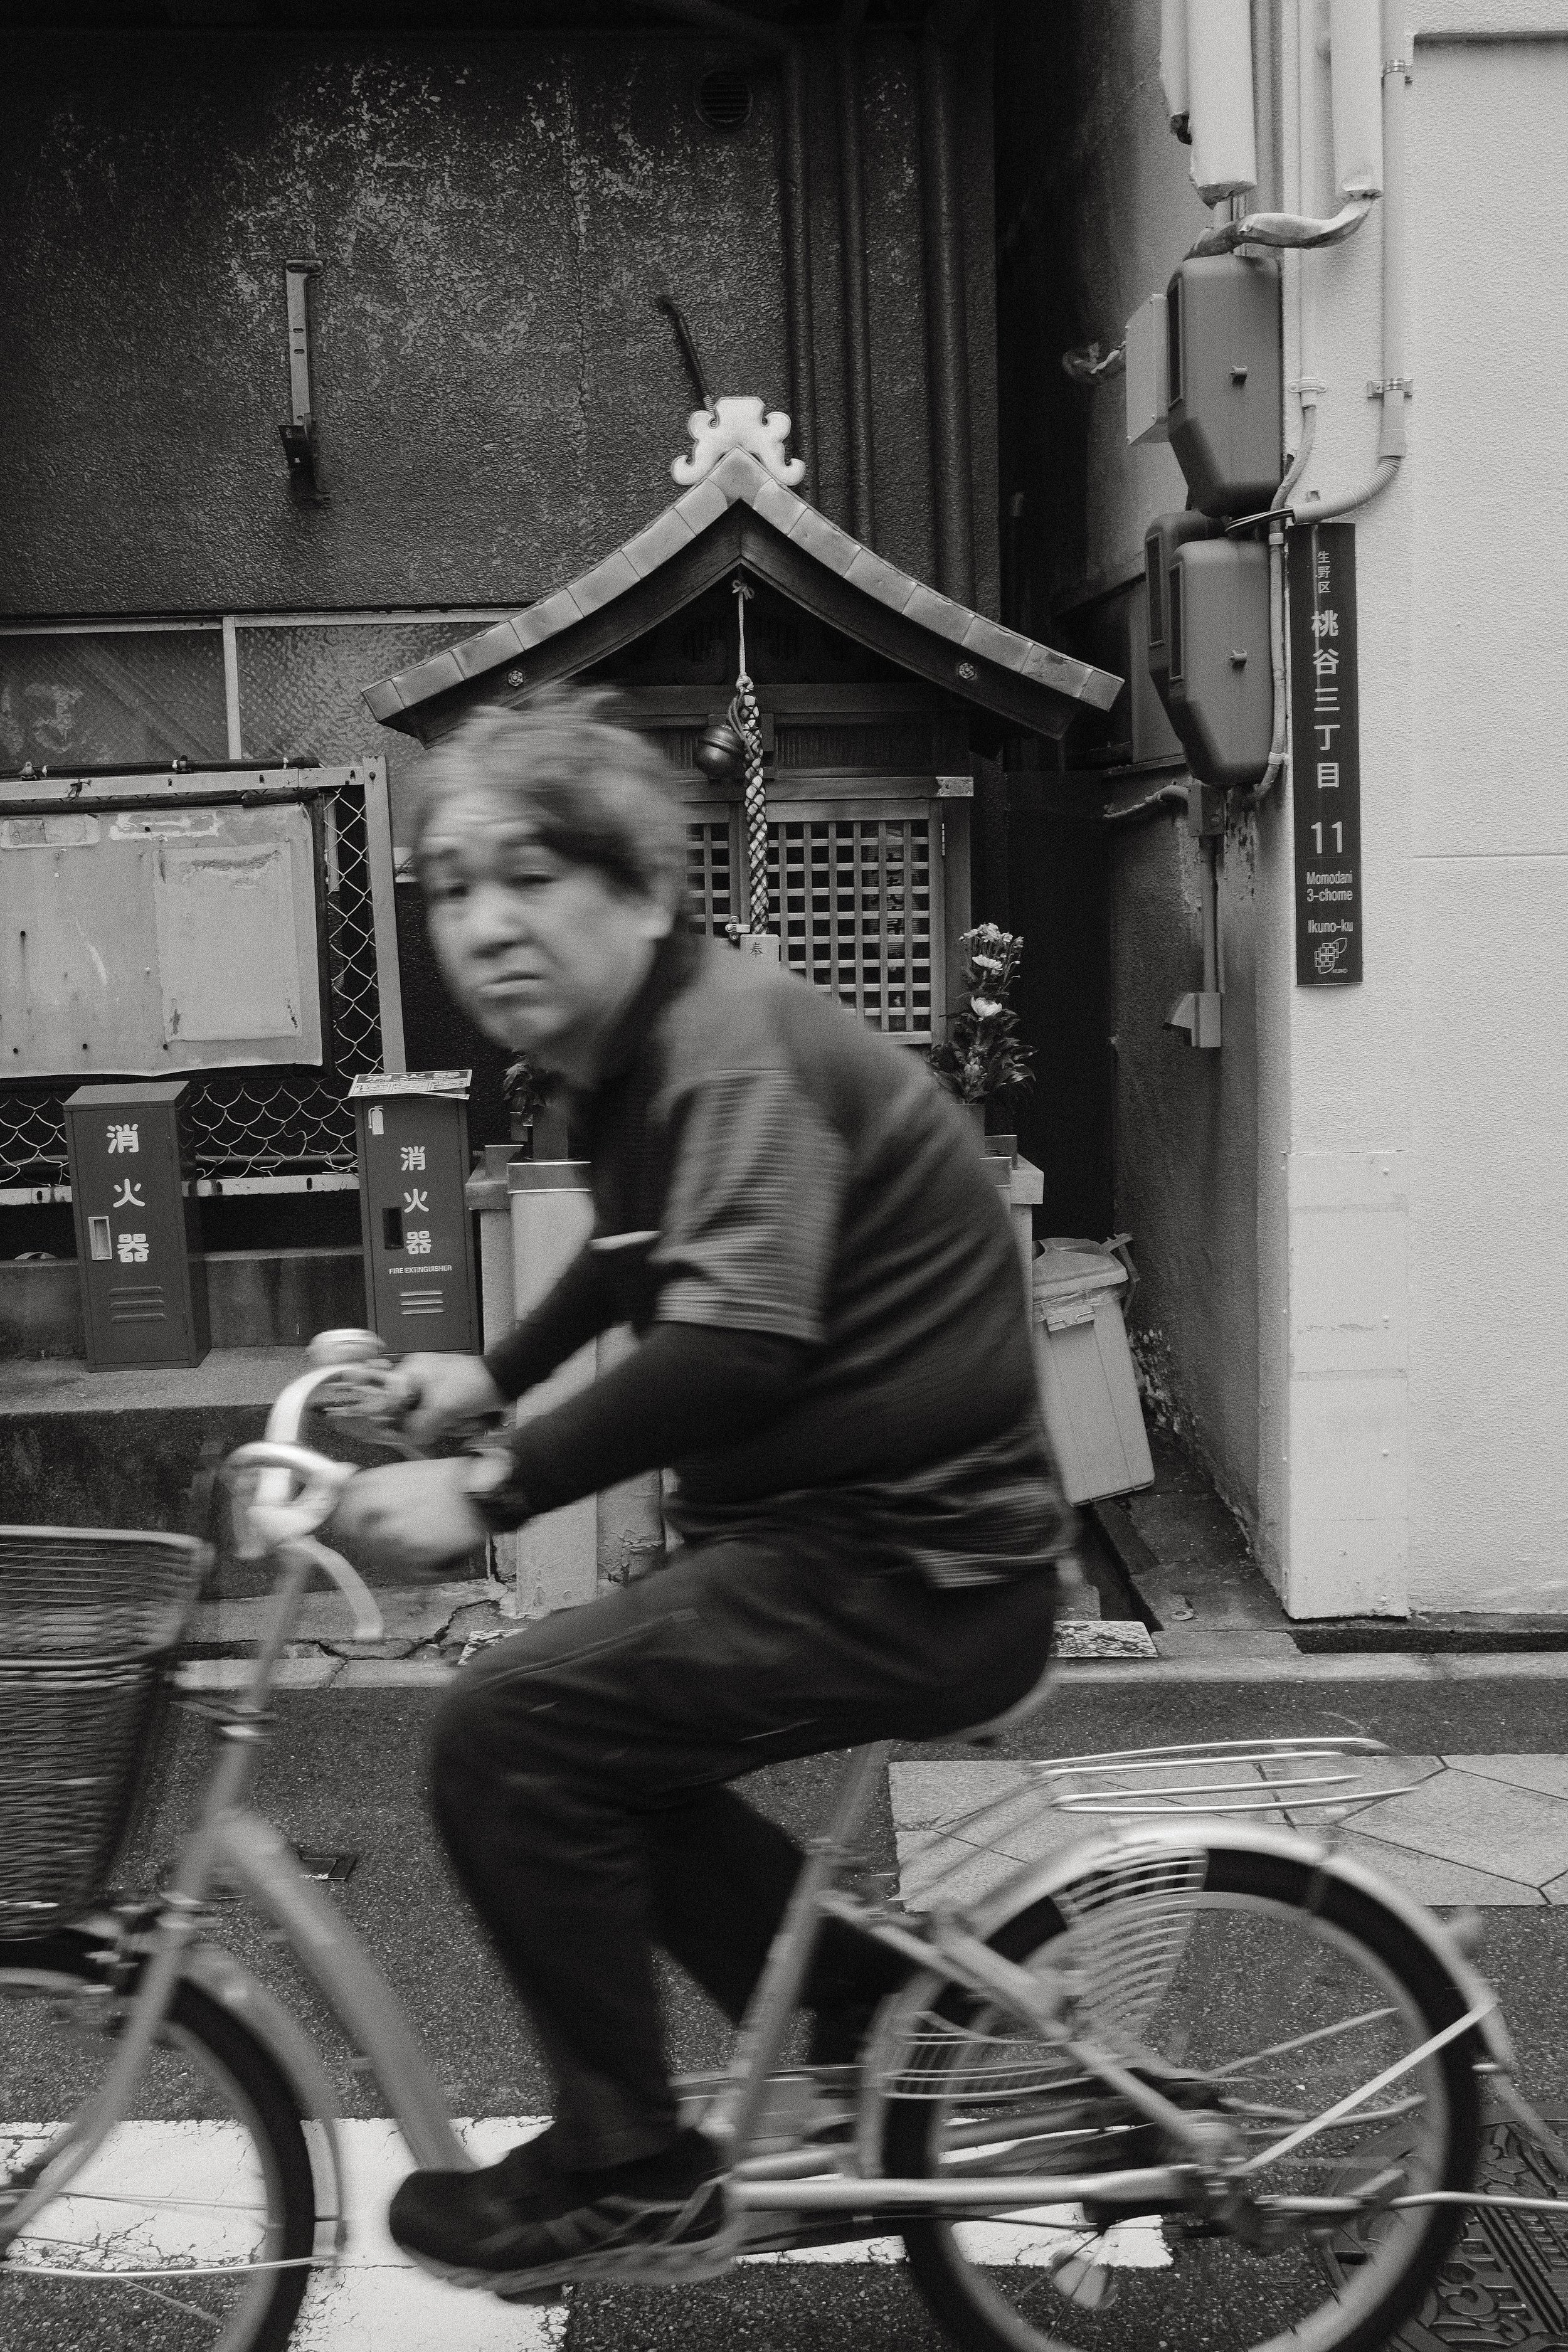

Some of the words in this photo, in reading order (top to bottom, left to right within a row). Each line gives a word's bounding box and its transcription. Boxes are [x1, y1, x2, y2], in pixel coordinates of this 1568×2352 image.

[1317, 551, 1332, 593] 生野区
[1311, 610, 1341, 788] 桃谷三丁目
[1310, 821, 1343, 854] 11
[1306, 870, 1353, 885] Momodani
[1306, 888, 1353, 902] 3-chome
[1308, 919, 1353, 933] Ikuno-ku
[107, 1123, 149, 1263] 消火器
[400, 1145, 432, 1254] 消火器
[405, 1265, 452, 1273] EXTINGUISHER
